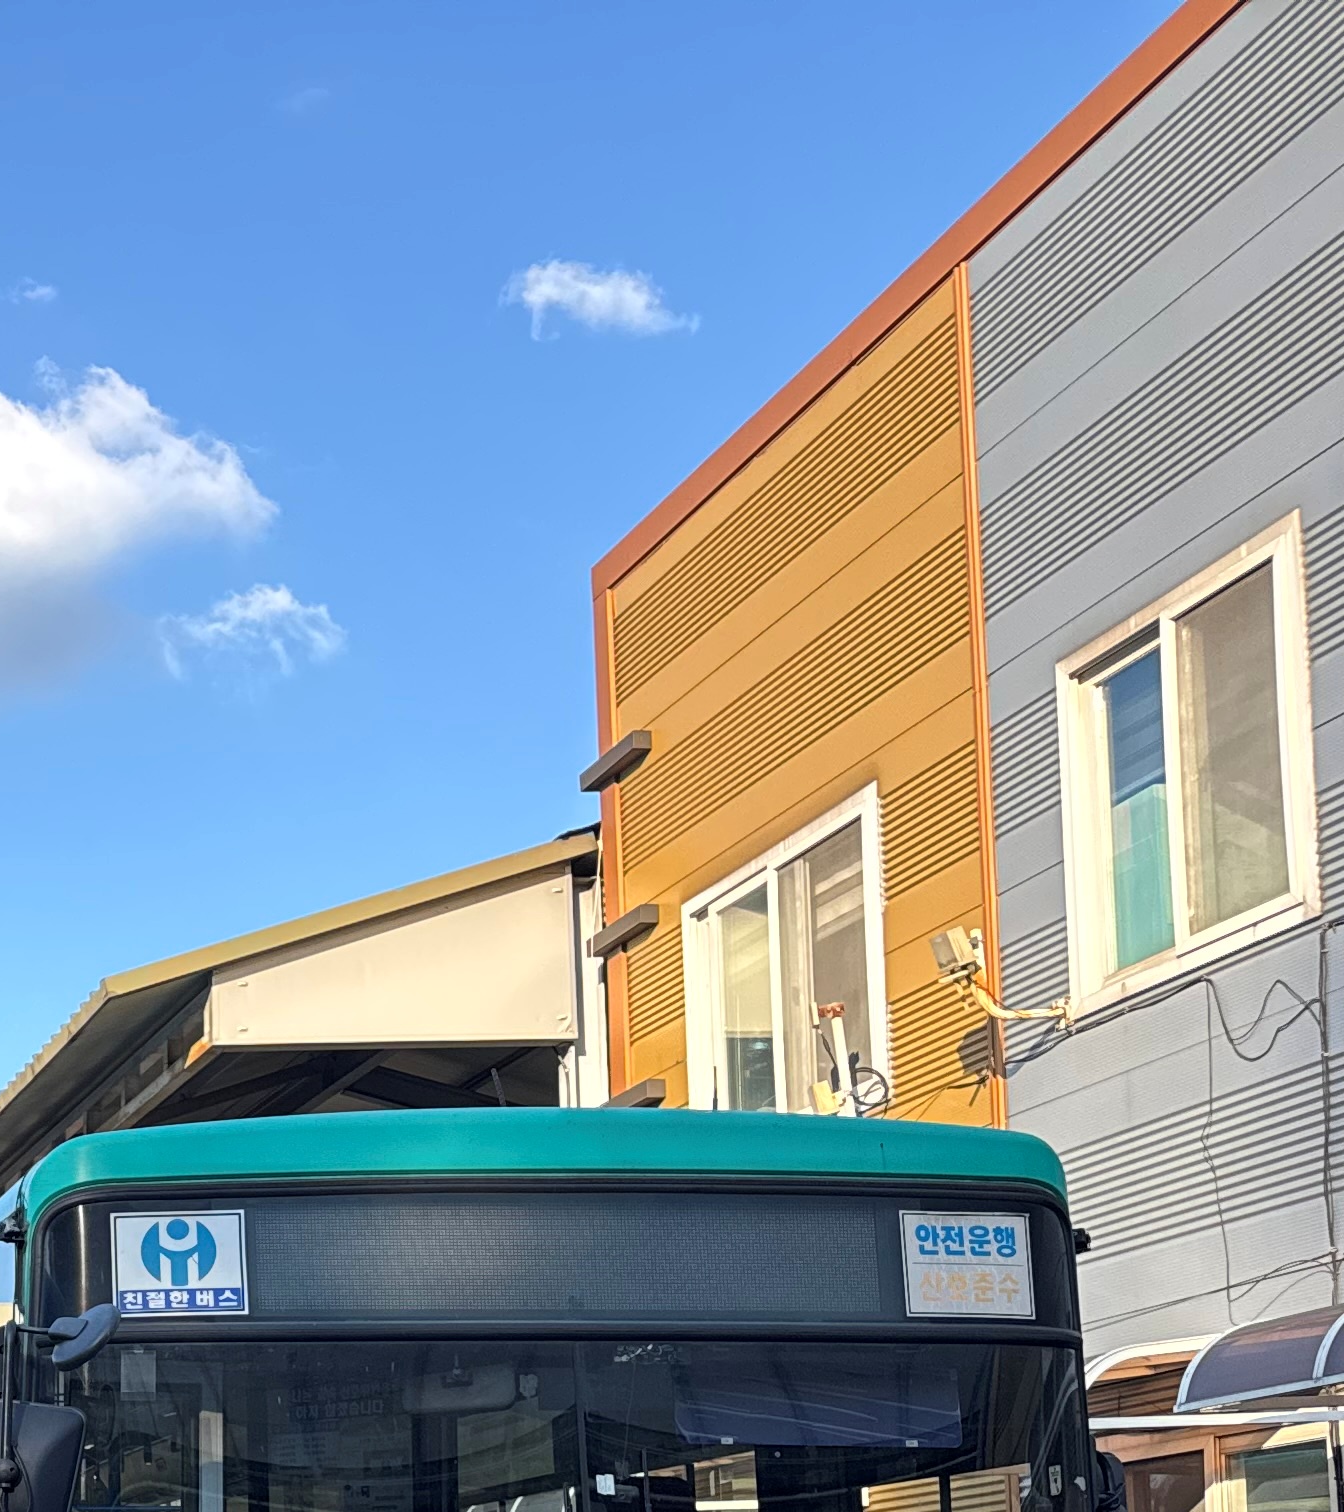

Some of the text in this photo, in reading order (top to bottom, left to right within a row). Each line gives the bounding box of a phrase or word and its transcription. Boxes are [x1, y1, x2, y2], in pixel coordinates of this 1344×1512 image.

[914, 1224, 1017, 1258] 안전운행
[123, 1289, 239, 1309] 친절한 버스
